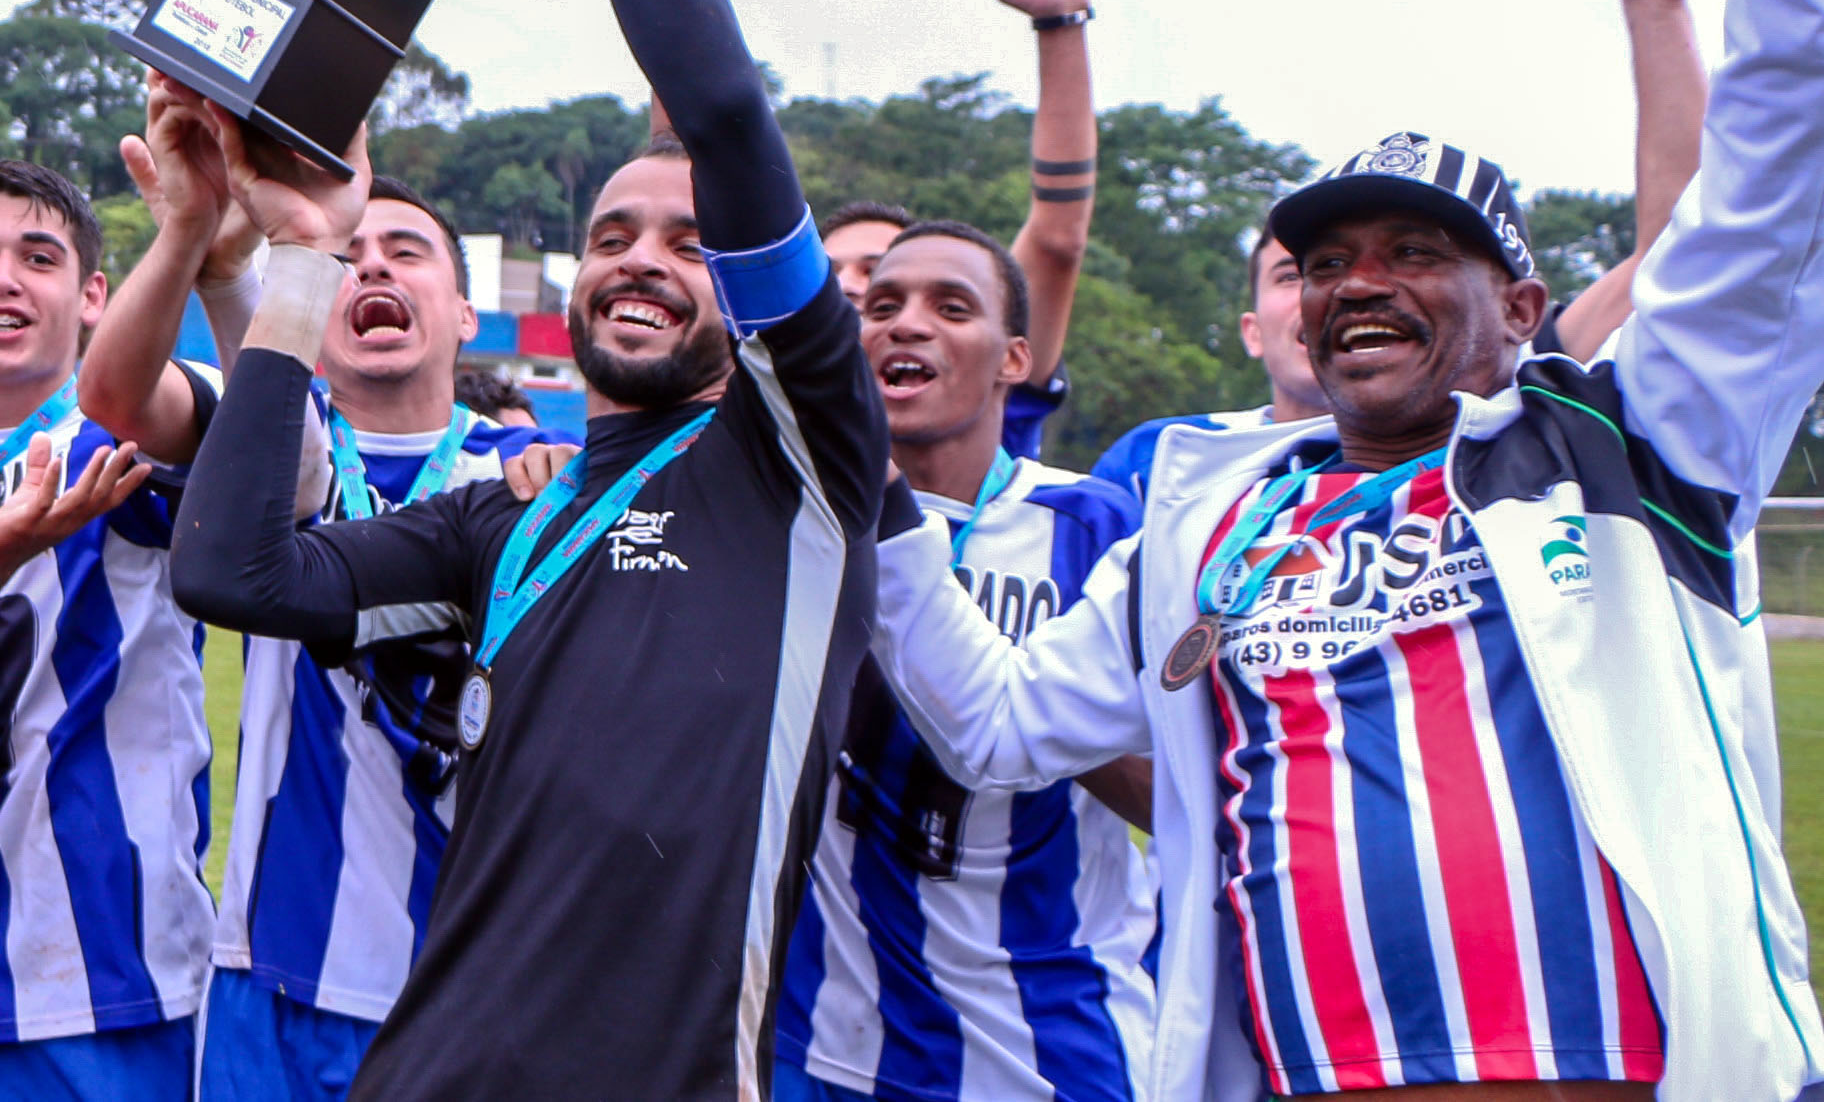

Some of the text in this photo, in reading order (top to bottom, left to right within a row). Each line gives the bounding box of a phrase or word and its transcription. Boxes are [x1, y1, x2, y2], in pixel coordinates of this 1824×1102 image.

[172, 0, 219, 31] APUCARANA
[1232, 640, 1283, 674] (43)
[1292, 641, 1312, 660] 9
